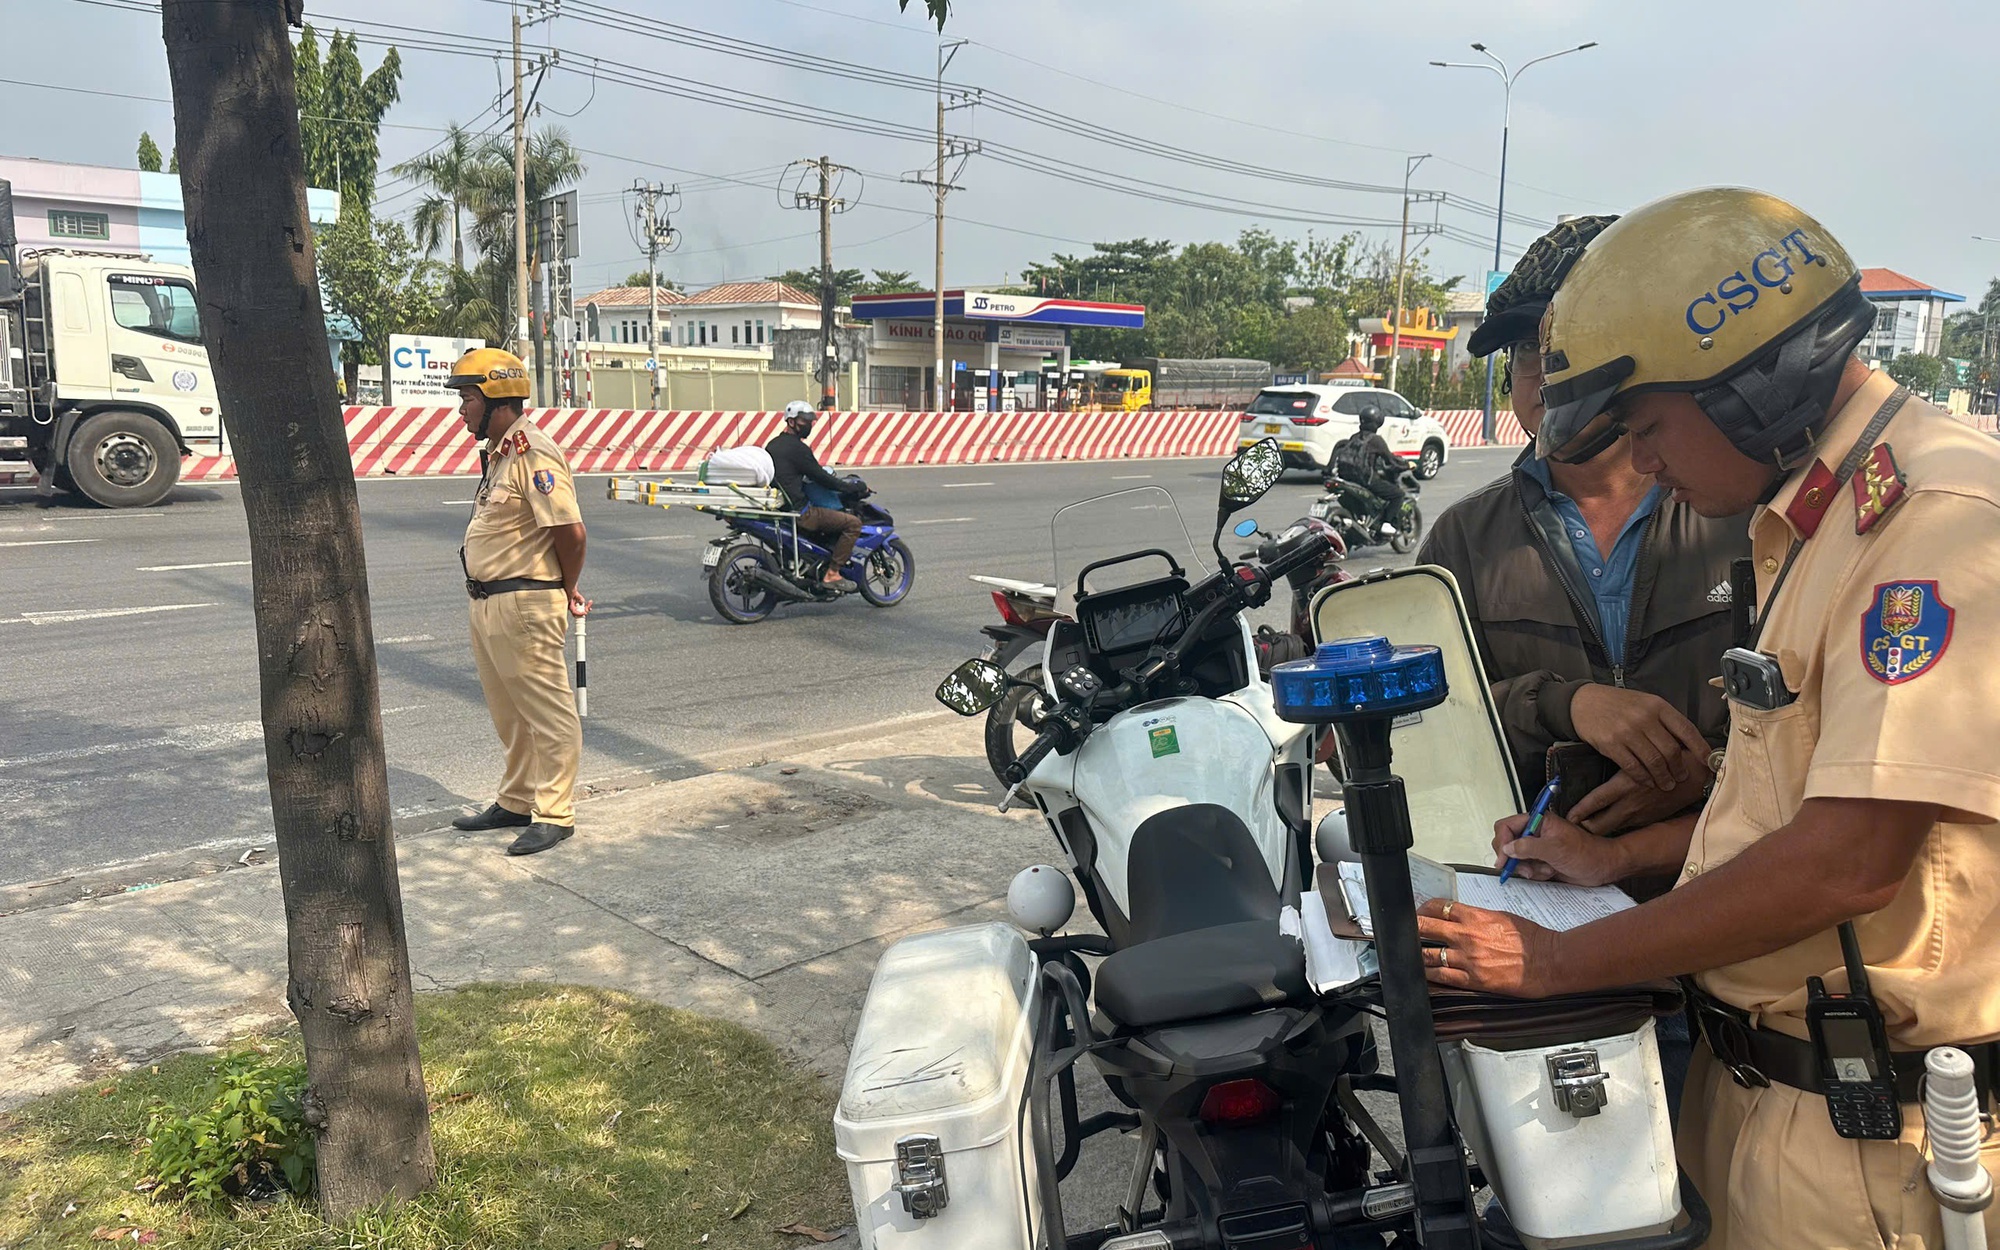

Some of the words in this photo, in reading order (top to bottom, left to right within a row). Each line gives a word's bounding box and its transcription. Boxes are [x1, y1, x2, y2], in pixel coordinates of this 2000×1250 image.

[1685, 228, 1817, 335] CSGT
[990, 304, 1015, 312] PETRO
[889, 324, 923, 337] KÍNH
[927, 325, 964, 341] CÀO
[969, 330, 986, 341] QU
[393, 347, 431, 369] CT
[489, 369, 524, 380] CSGT
[1706, 593, 1732, 602] adid
[1845, 1062, 1855, 1078] 6
